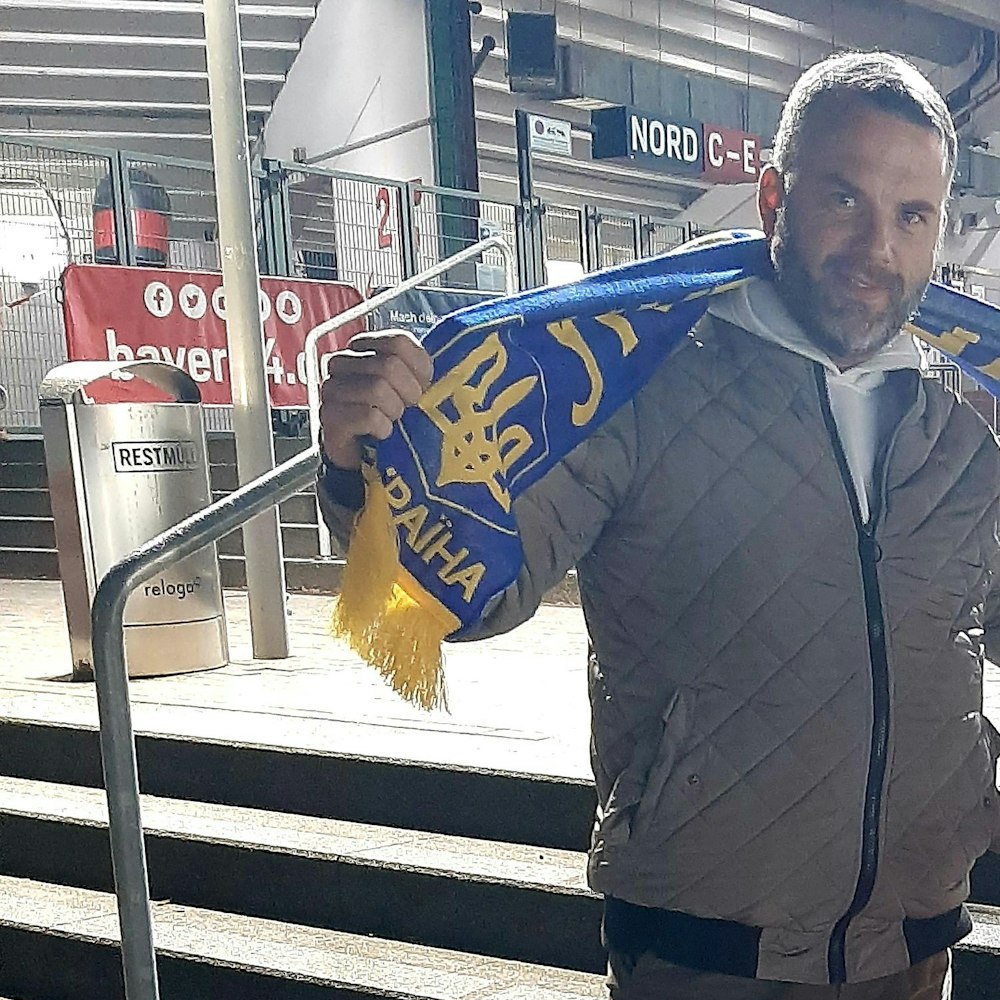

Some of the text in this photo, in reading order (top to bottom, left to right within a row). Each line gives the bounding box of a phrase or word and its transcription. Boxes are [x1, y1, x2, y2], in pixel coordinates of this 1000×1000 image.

[630, 115, 699, 162] NORD
[390, 310, 417, 323] Mach
[385, 466, 487, 604] РАЇНА
